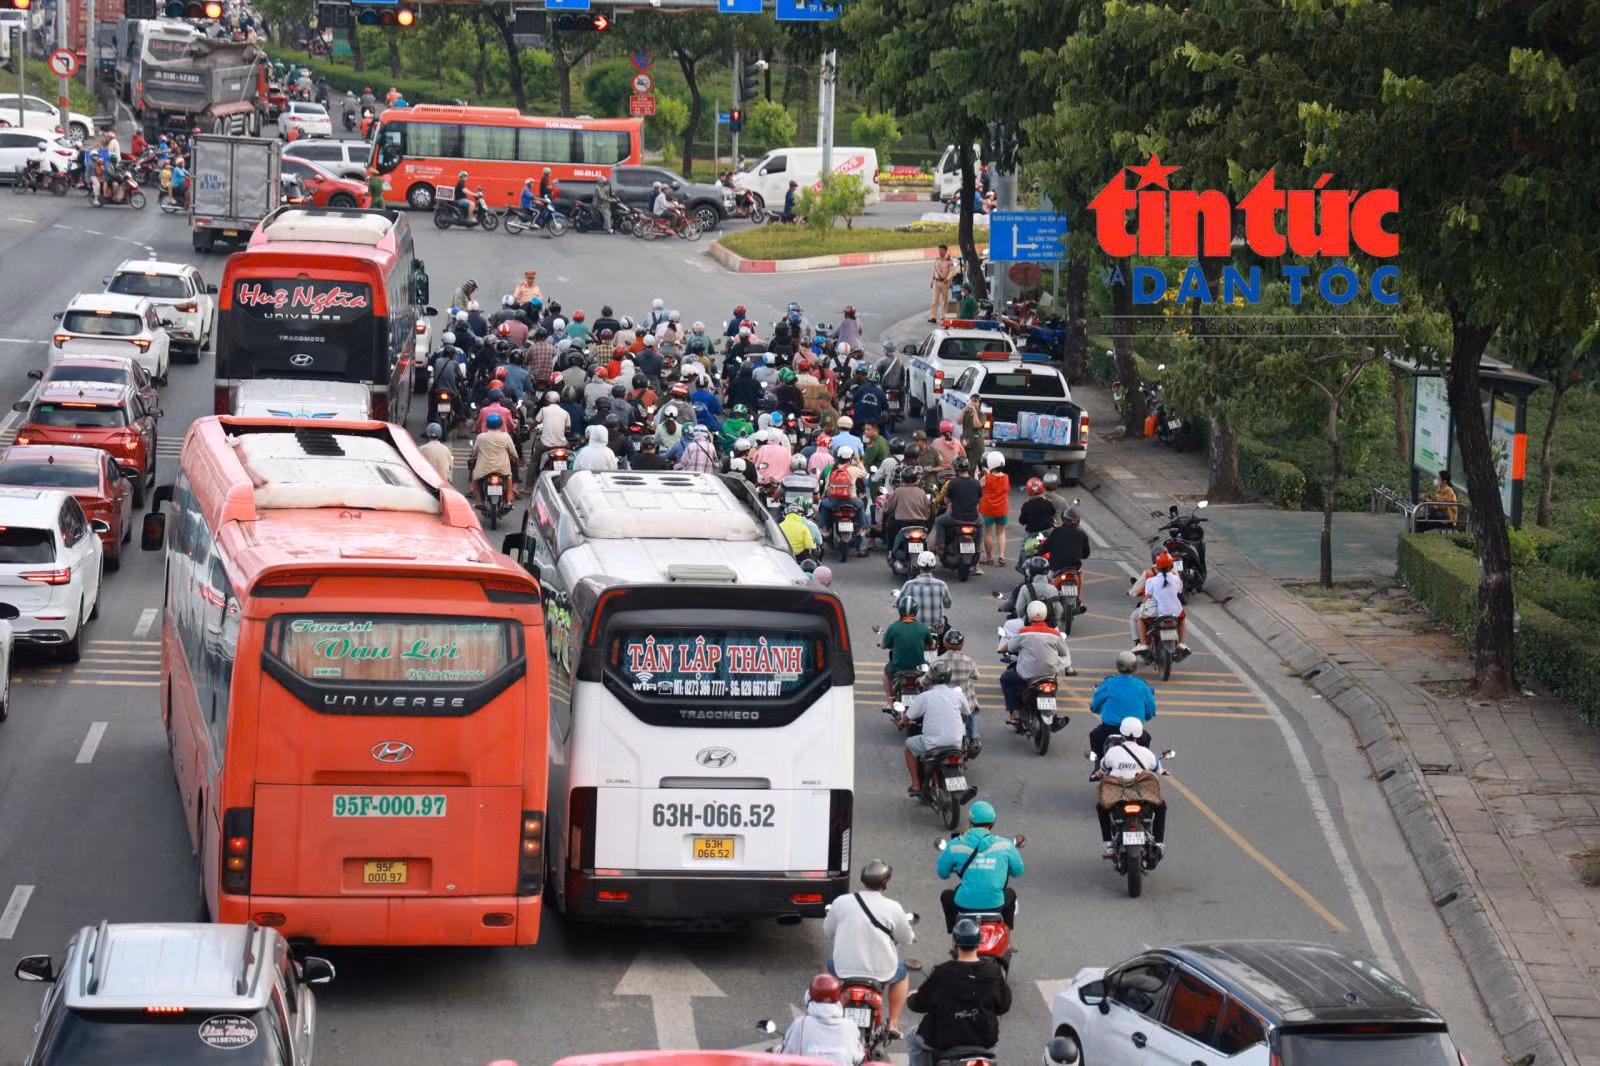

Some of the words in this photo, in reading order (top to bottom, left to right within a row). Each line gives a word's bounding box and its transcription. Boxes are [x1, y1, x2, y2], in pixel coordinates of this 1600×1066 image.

[240, 284, 288, 308] Huệ
[292, 286, 367, 314] Nghĩa
[314, 638, 392, 664] Vạn
[627, 634, 674, 672] TÂN
[678, 635, 722, 680] LẬP
[726, 636, 803, 674] THÀNH
[324, 694, 465, 707] UNIVERSE
[680, 710, 759, 720] TRACOMECO
[335, 796, 445, 816] 95F-000.97
[652, 804, 775, 828] 63H-066.52
[704, 840, 723, 848] 63H
[376, 863, 394, 872] 95F
[368, 873, 402, 882] 000.97
